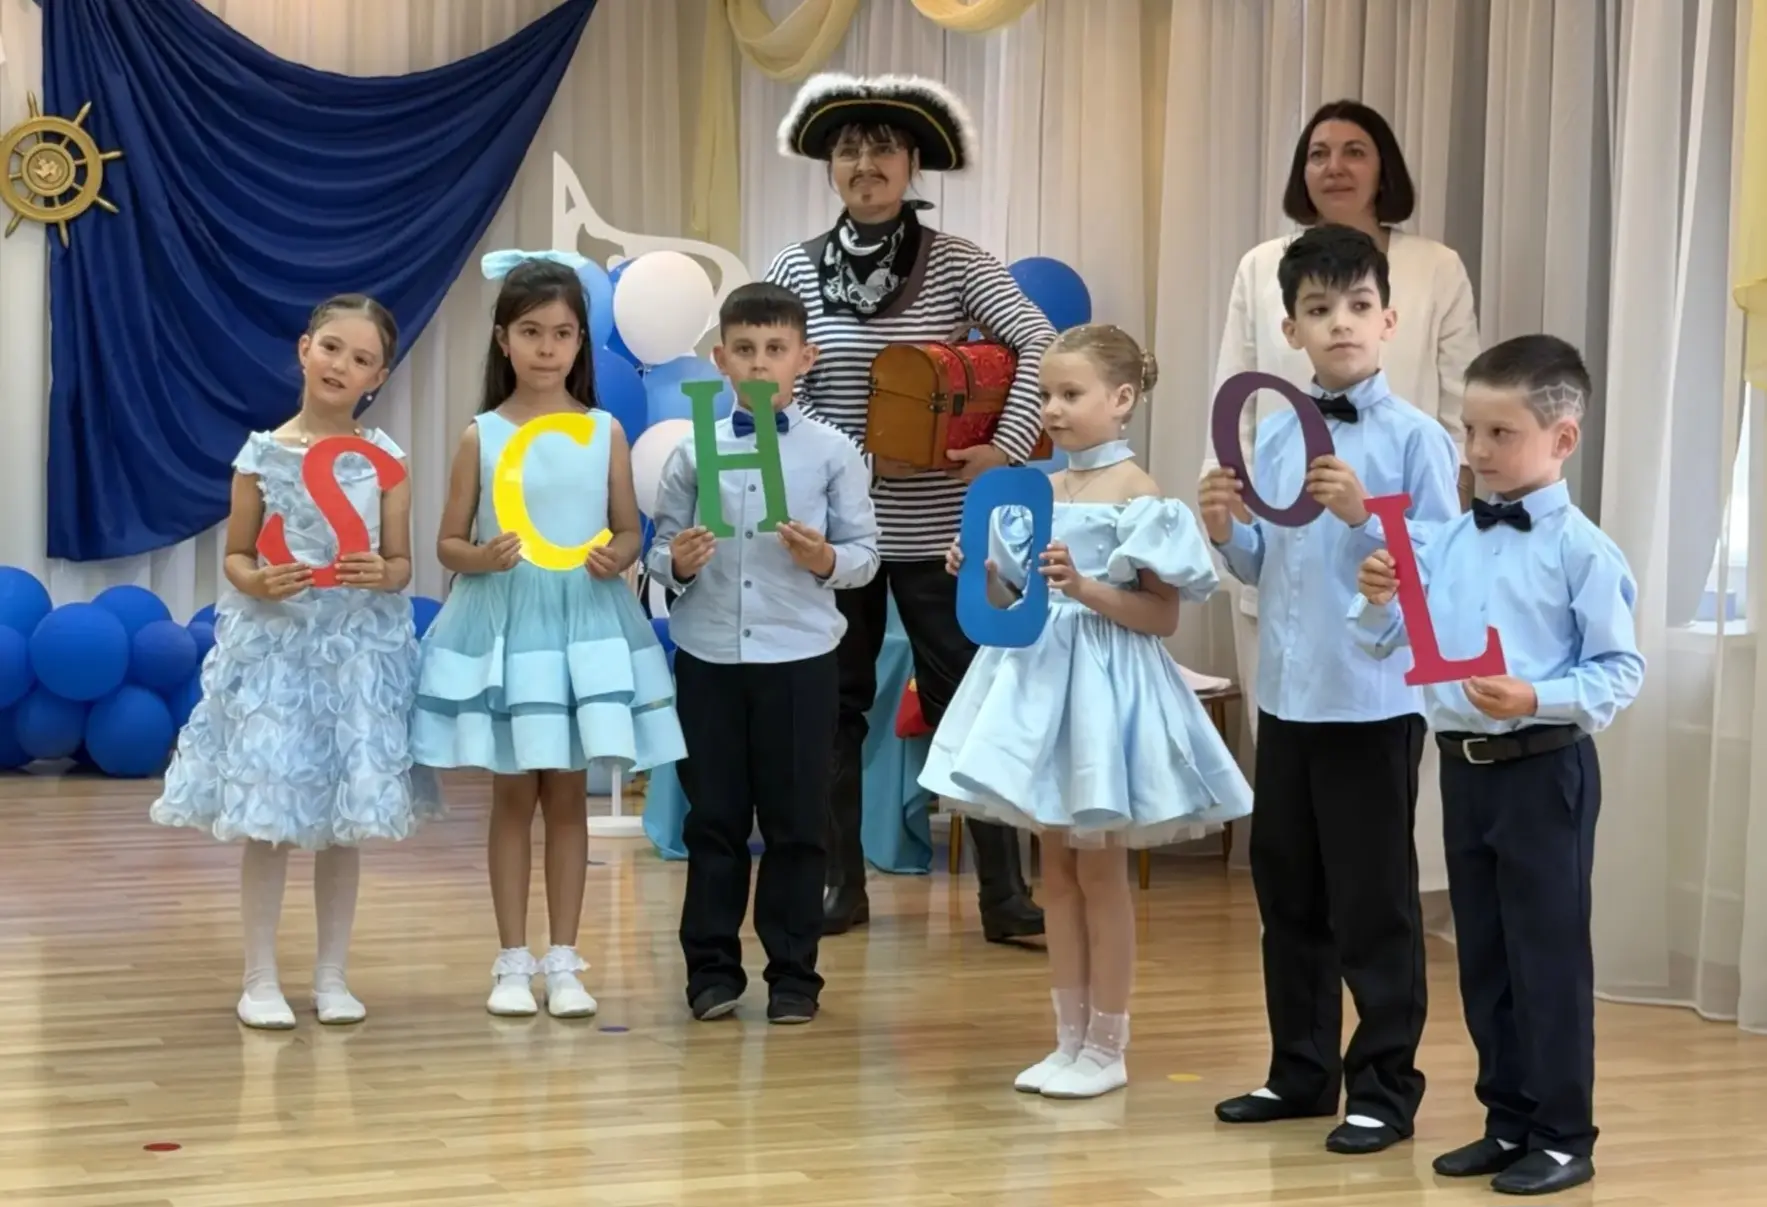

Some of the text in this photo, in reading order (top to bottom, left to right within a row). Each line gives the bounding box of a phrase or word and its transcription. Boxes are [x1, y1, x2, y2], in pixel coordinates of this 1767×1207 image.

[256, 435, 407, 588] S
[493, 412, 613, 571] C
[680, 379, 790, 538] H
[1212, 371, 1336, 527] O
[1364, 493, 1507, 686] L
